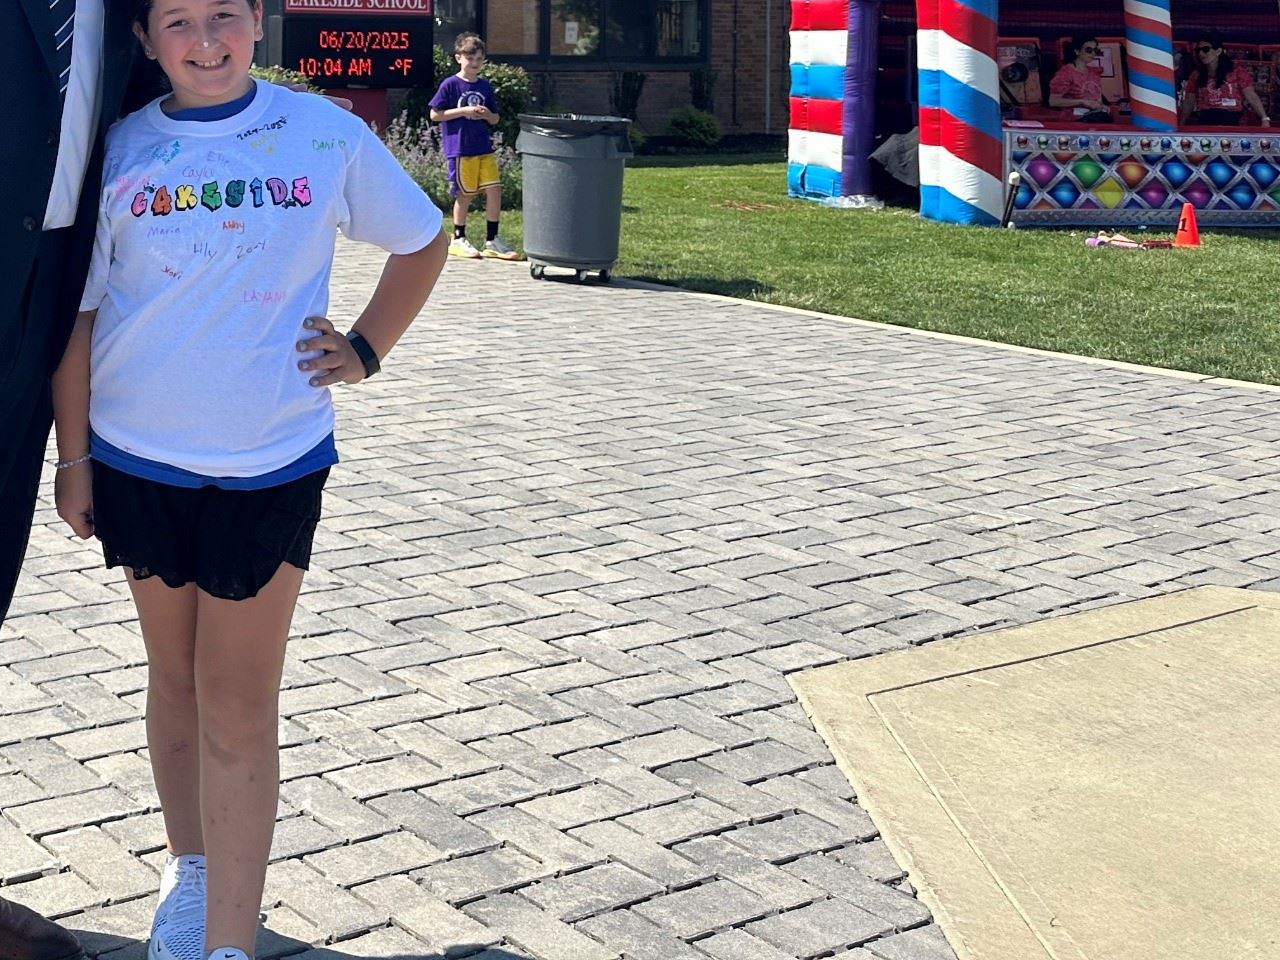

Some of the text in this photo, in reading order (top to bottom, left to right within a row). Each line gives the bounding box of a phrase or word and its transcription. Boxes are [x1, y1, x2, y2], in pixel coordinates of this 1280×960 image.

[319, 30, 410, 53] 06/20/2025
[298, 57, 343, 77] 10:04
[348, 58, 373, 76] AM
[1179, 217, 1188, 233] 1
